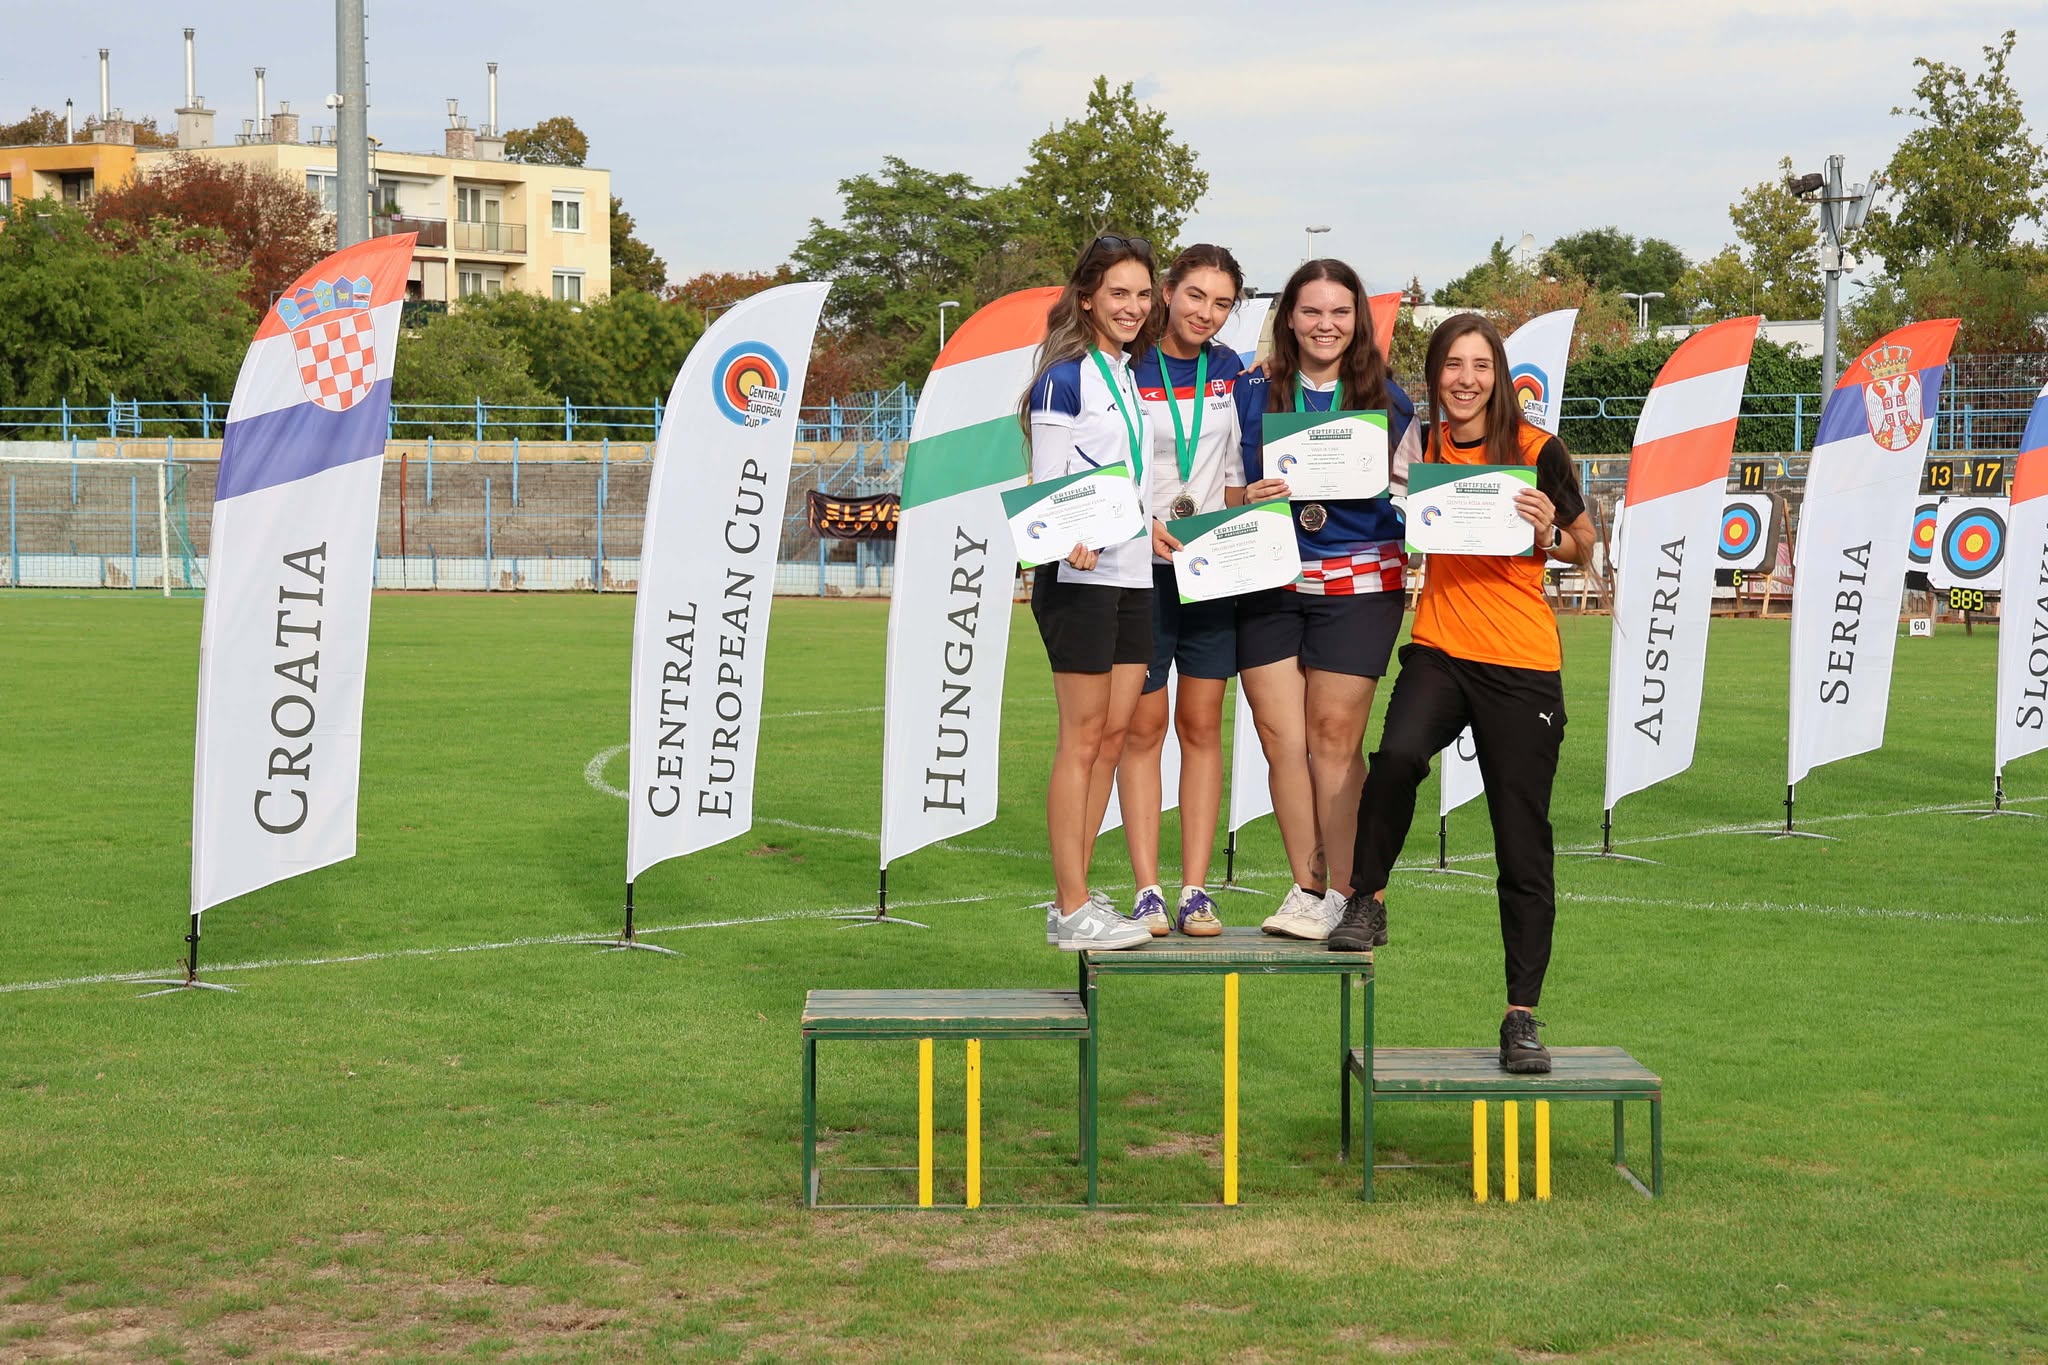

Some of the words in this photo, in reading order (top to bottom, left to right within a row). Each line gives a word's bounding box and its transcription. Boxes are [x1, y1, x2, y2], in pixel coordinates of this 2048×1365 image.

[749, 384, 781, 403] CENTRAL
[746, 400, 782, 418] EUROPEAN
[744, 414, 760, 428] CUP
[1307, 427, 1354, 436] CERTIFICATE
[1453, 481, 1501, 490] CERTIFICATE
[1744, 465, 1761, 487] 11
[1930, 465, 1951, 486] 13
[1975, 463, 2001, 487] 17
[725, 459, 768, 554] CUP
[1213, 520, 1259, 535] CERTIFICATE
[1732, 569, 1742, 586] 6
[1950, 588, 1984, 611] 889
[1820, 541, 1872, 705] SERBIA
[1914, 620, 1926, 631] 60
[1634, 535, 1686, 746] AUSTRIA
[924, 526, 988, 815] HUNGARY
[254, 542, 327, 834] CROATIA
[698, 568, 753, 818] EUROPEAN
[648, 602, 697, 817] CENTRAL
